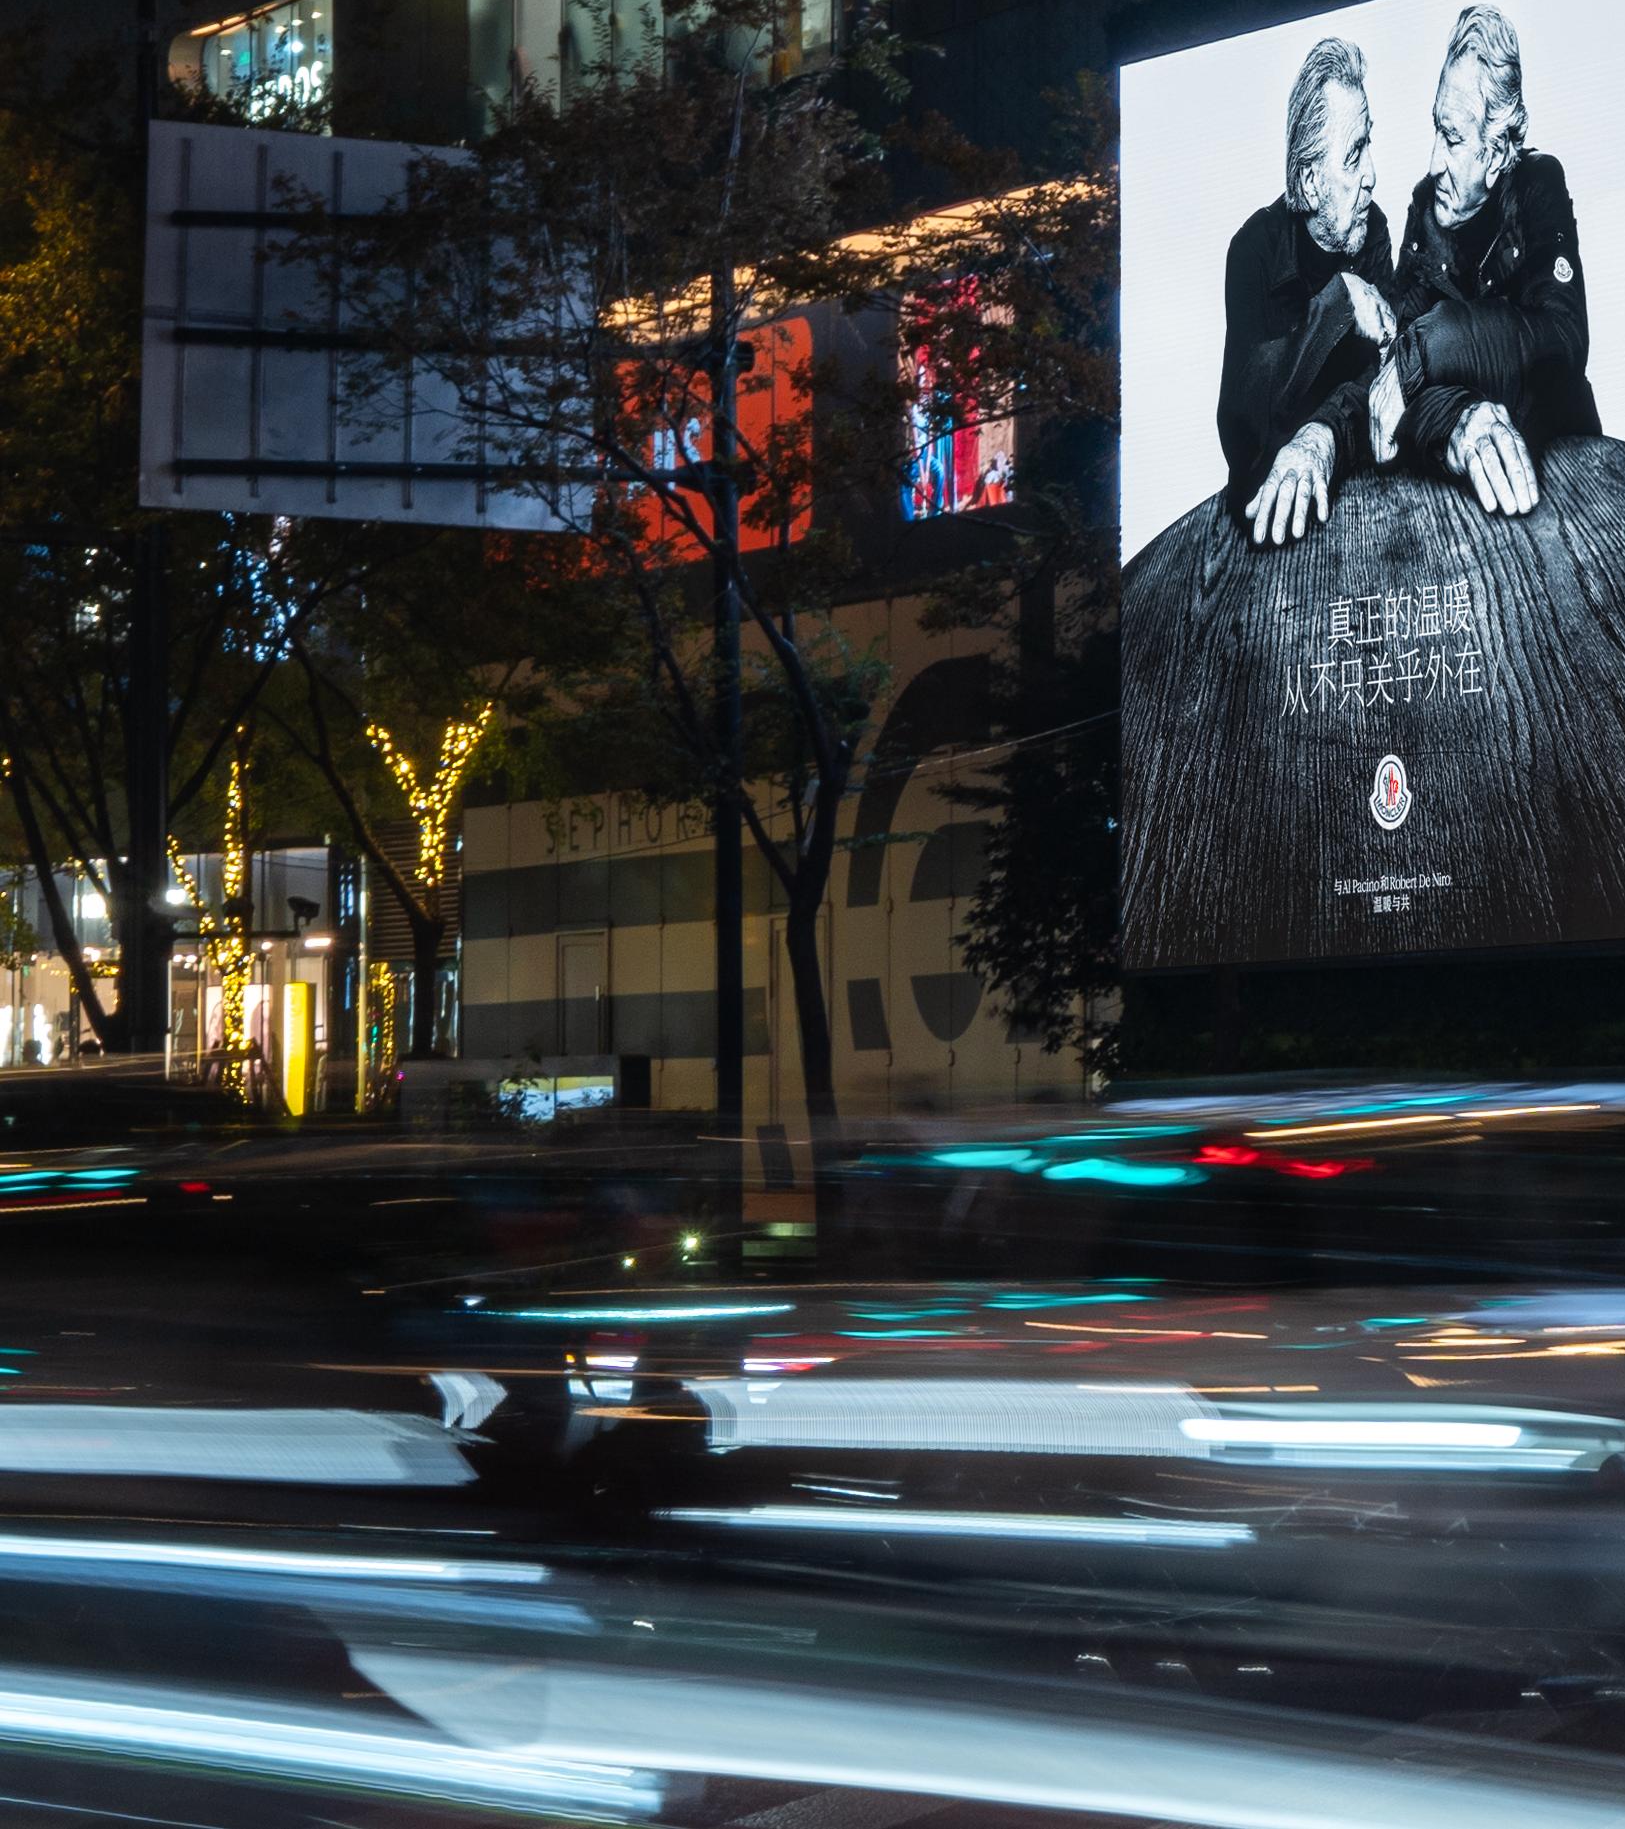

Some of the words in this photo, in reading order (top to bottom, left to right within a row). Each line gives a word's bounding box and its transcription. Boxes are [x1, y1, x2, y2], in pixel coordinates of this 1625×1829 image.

[1327, 578, 1472, 651] 真正的温暖
[1281, 640, 1484, 717] 从不只关乎外在
[1373, 894, 1411, 913] 温暖与共
